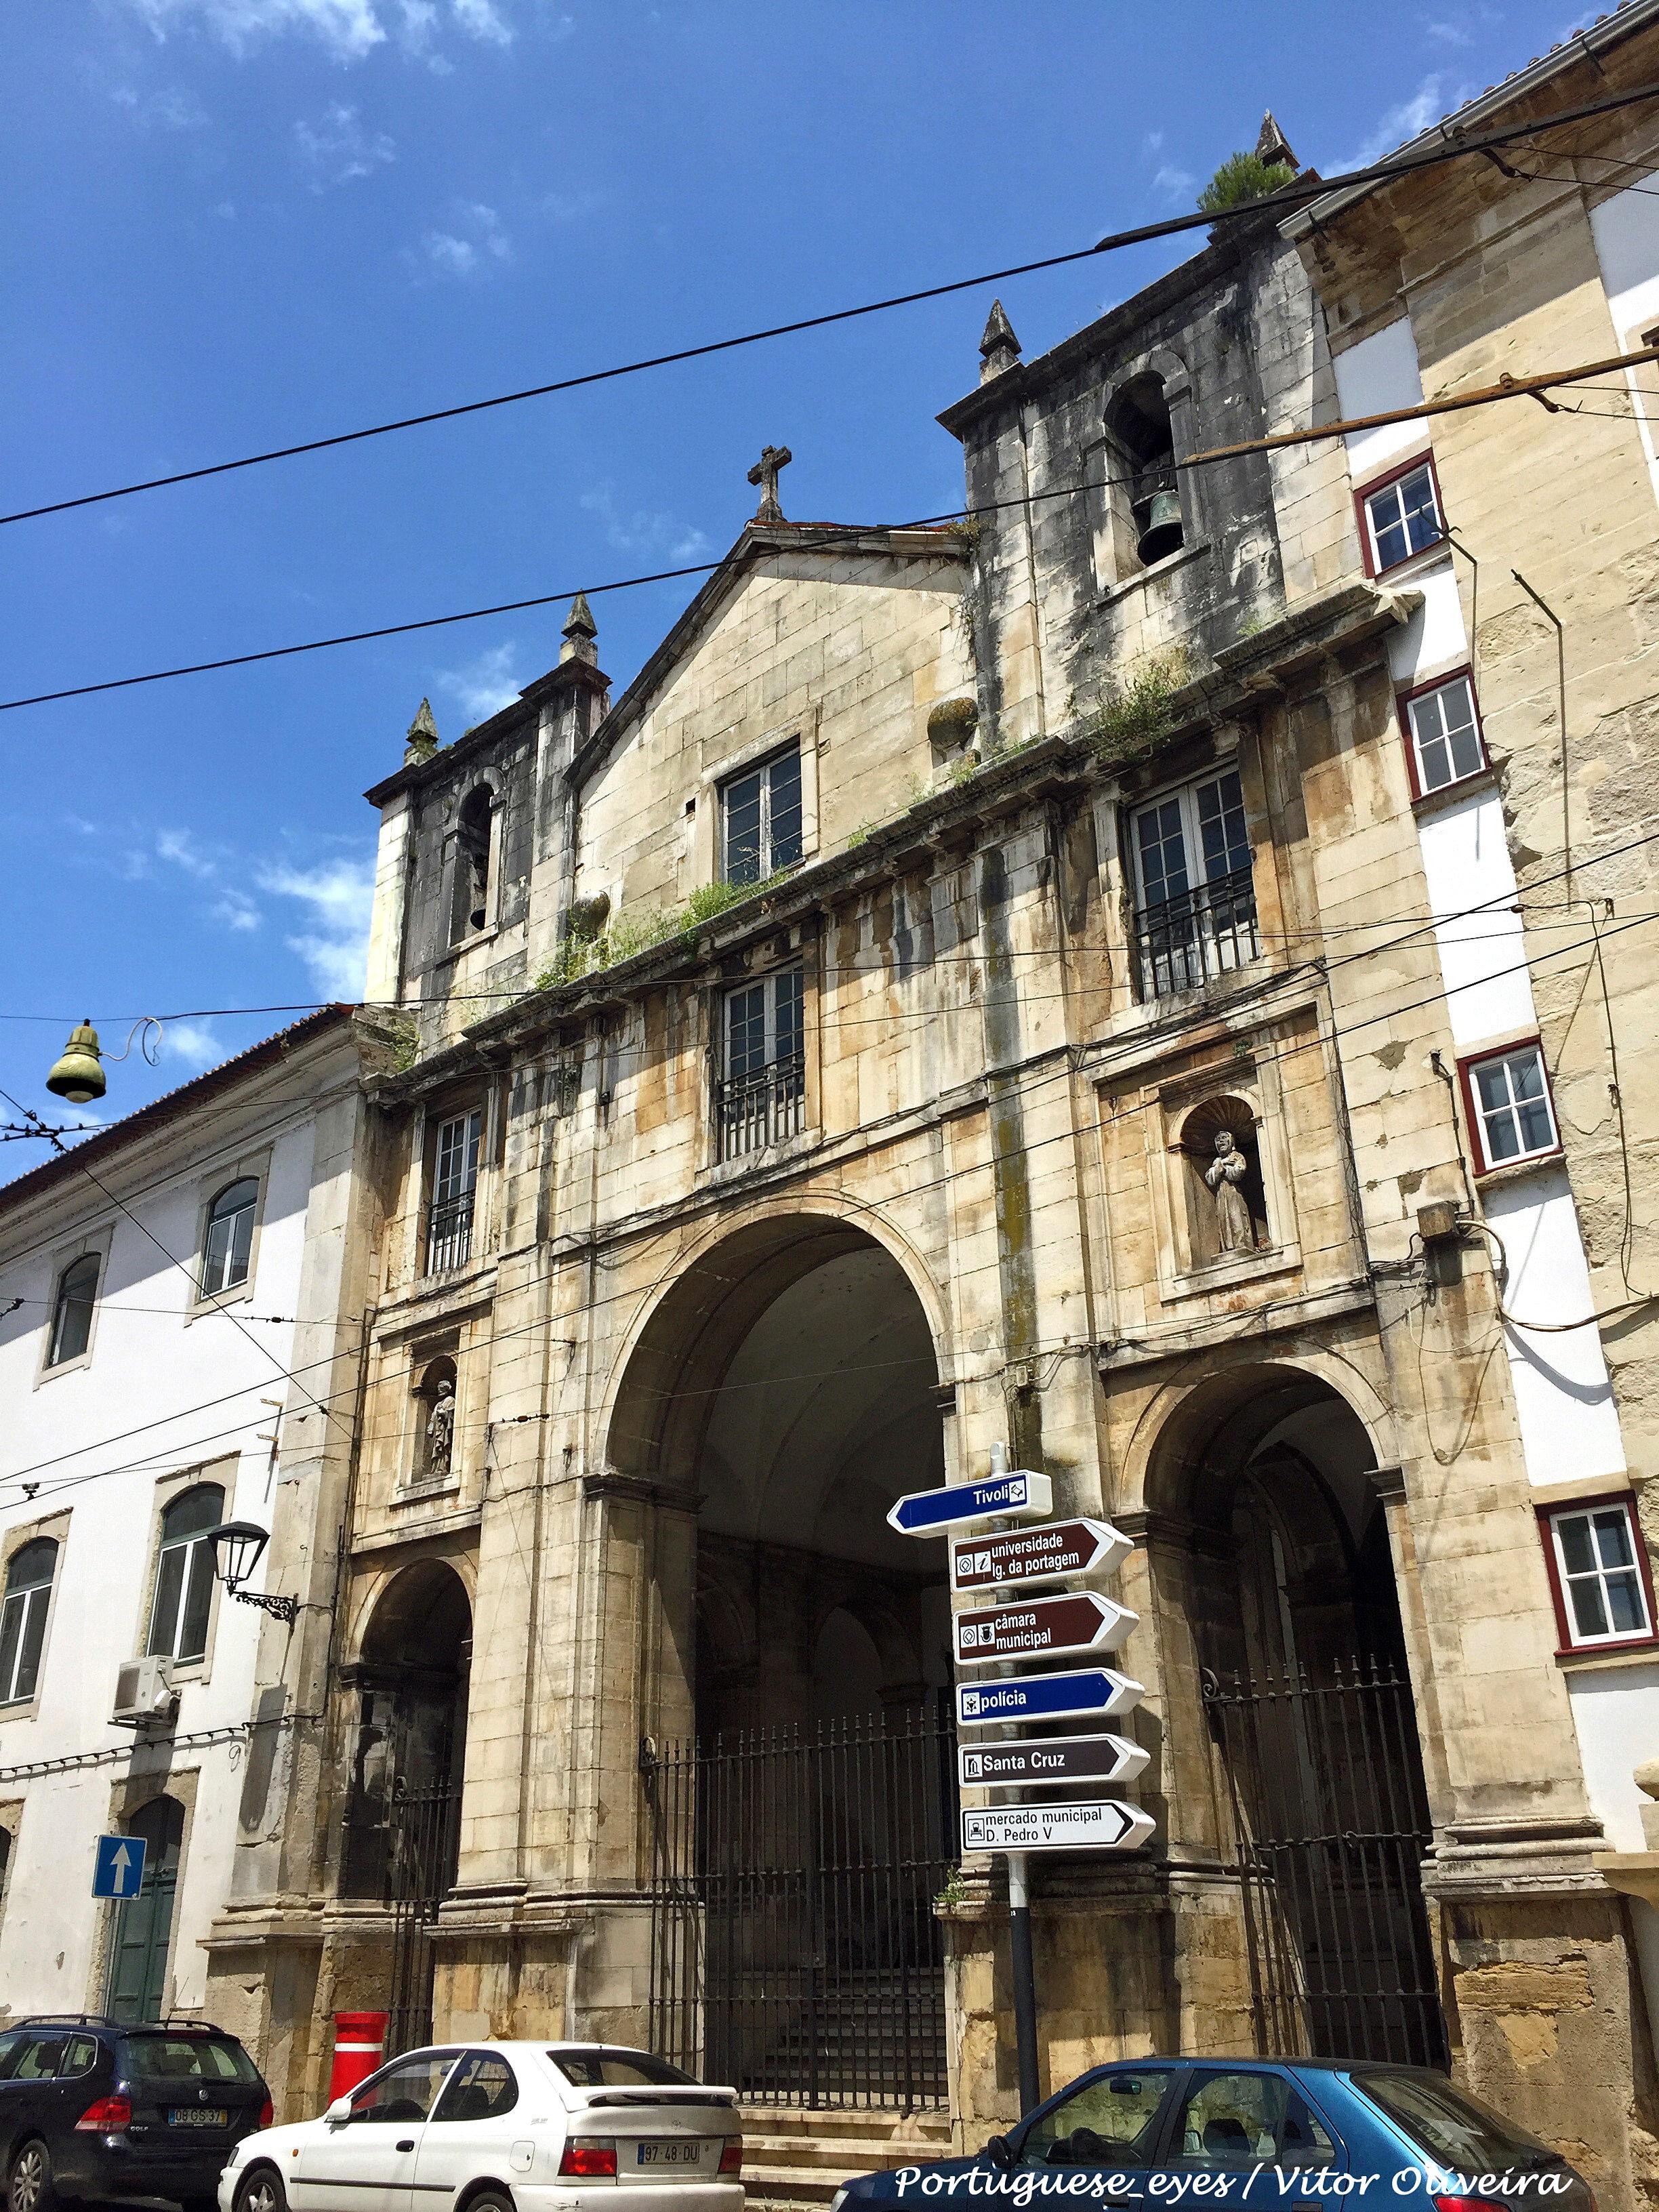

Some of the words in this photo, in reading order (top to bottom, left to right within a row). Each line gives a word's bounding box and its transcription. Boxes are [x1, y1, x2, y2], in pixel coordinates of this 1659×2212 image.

[973, 1484, 1009, 1506] Tivoli
[991, 1533, 1063, 1559] universidade
[1008, 1558, 1023, 1575] da
[1025, 1551, 1080, 1576] portagem
[995, 1612, 1036, 1630] câmara
[996, 1628, 1051, 1650] municipal
[981, 1689, 1027, 1712] polícia
[983, 1755, 1026, 1772] Santa
[1031, 1751, 1066, 1769] Cruz
[985, 1811, 1038, 1827] mercado
[1042, 1807, 1102, 1828] municipal
[986, 1828, 1000, 1843] D.
[1004, 1827, 1039, 1842] Pedro
[1043, 1826, 1052, 1840] V
